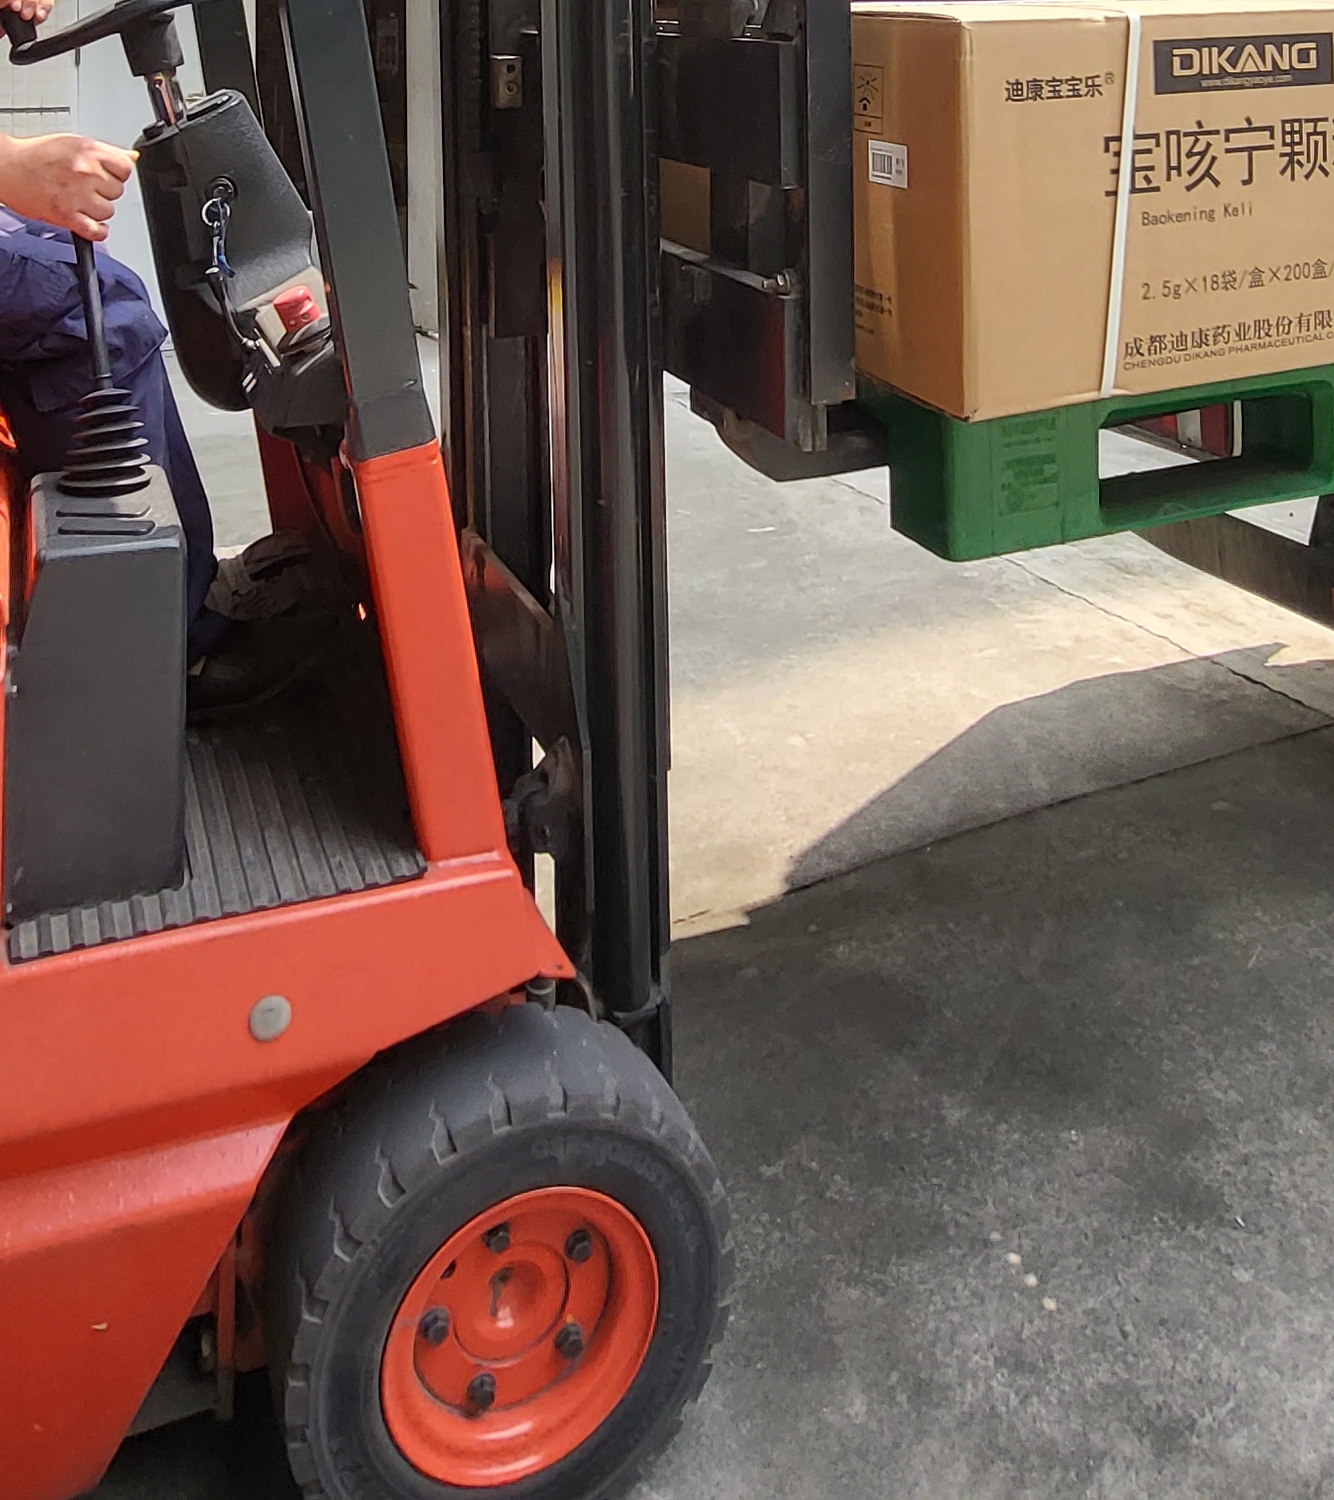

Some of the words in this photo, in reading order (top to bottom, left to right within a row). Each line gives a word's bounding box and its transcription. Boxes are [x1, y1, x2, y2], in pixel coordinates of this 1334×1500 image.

[1171, 41, 1318, 77] DIKANG
[1141, 207, 1216, 227] Baokening
[1223, 201, 1254, 218] Keli
[1123, 355, 1182, 371] CHENGDU
[1183, 347, 1226, 363] DIKANG
[1228, 332, 1325, 355] PHARMACEUTICAL
